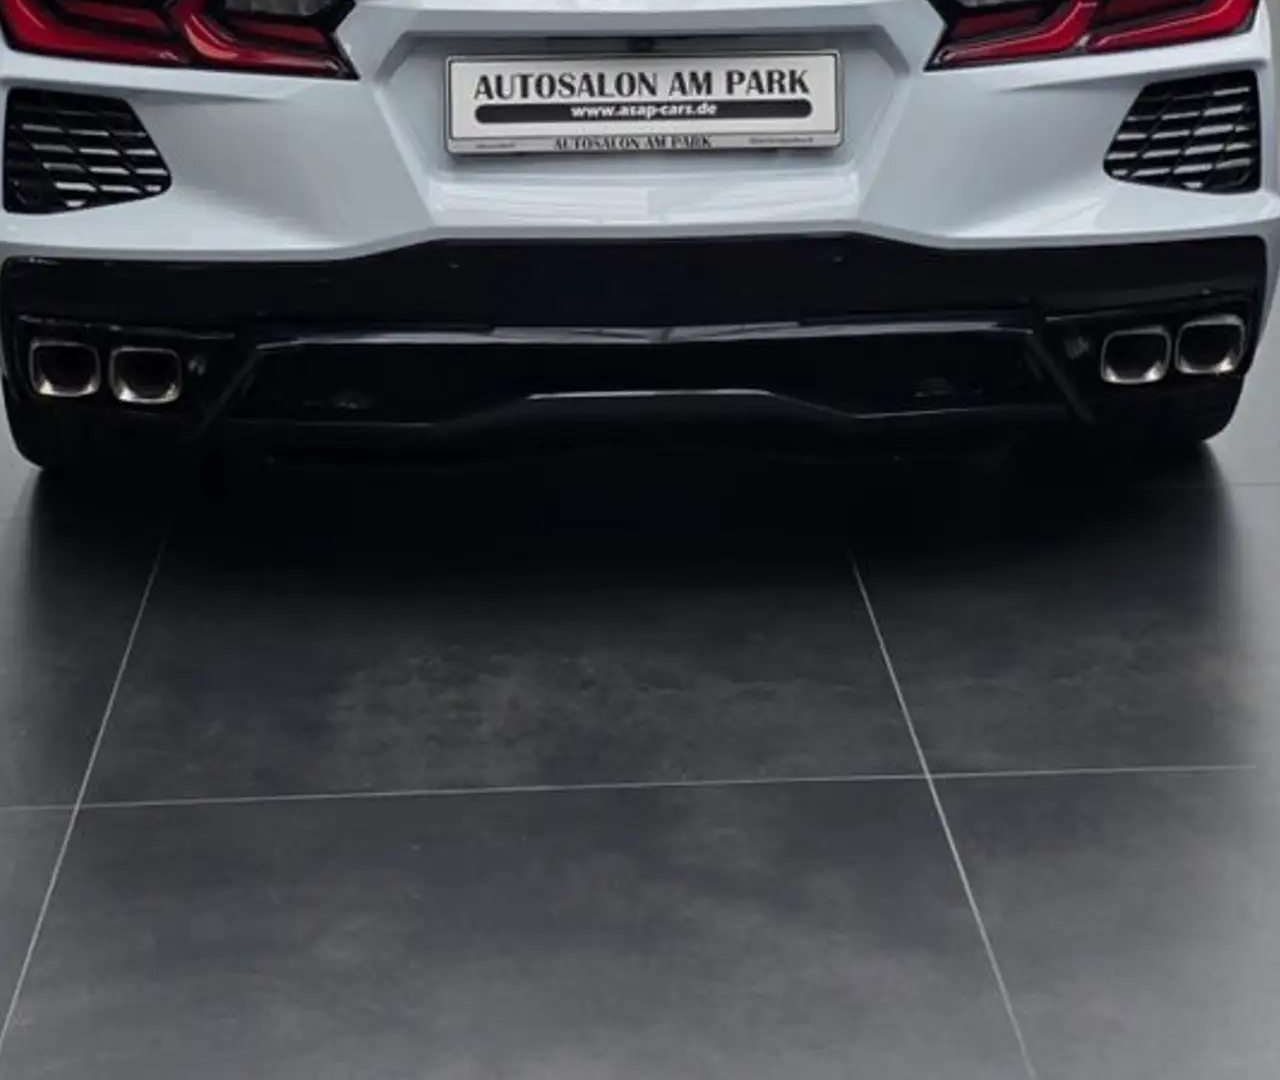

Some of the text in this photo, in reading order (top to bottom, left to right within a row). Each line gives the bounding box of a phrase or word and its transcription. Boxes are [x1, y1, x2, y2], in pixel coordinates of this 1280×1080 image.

[473, 69, 810, 100] AUTOSALON AM PARK
[570, 103, 718, 119] www.asap-cars.de
